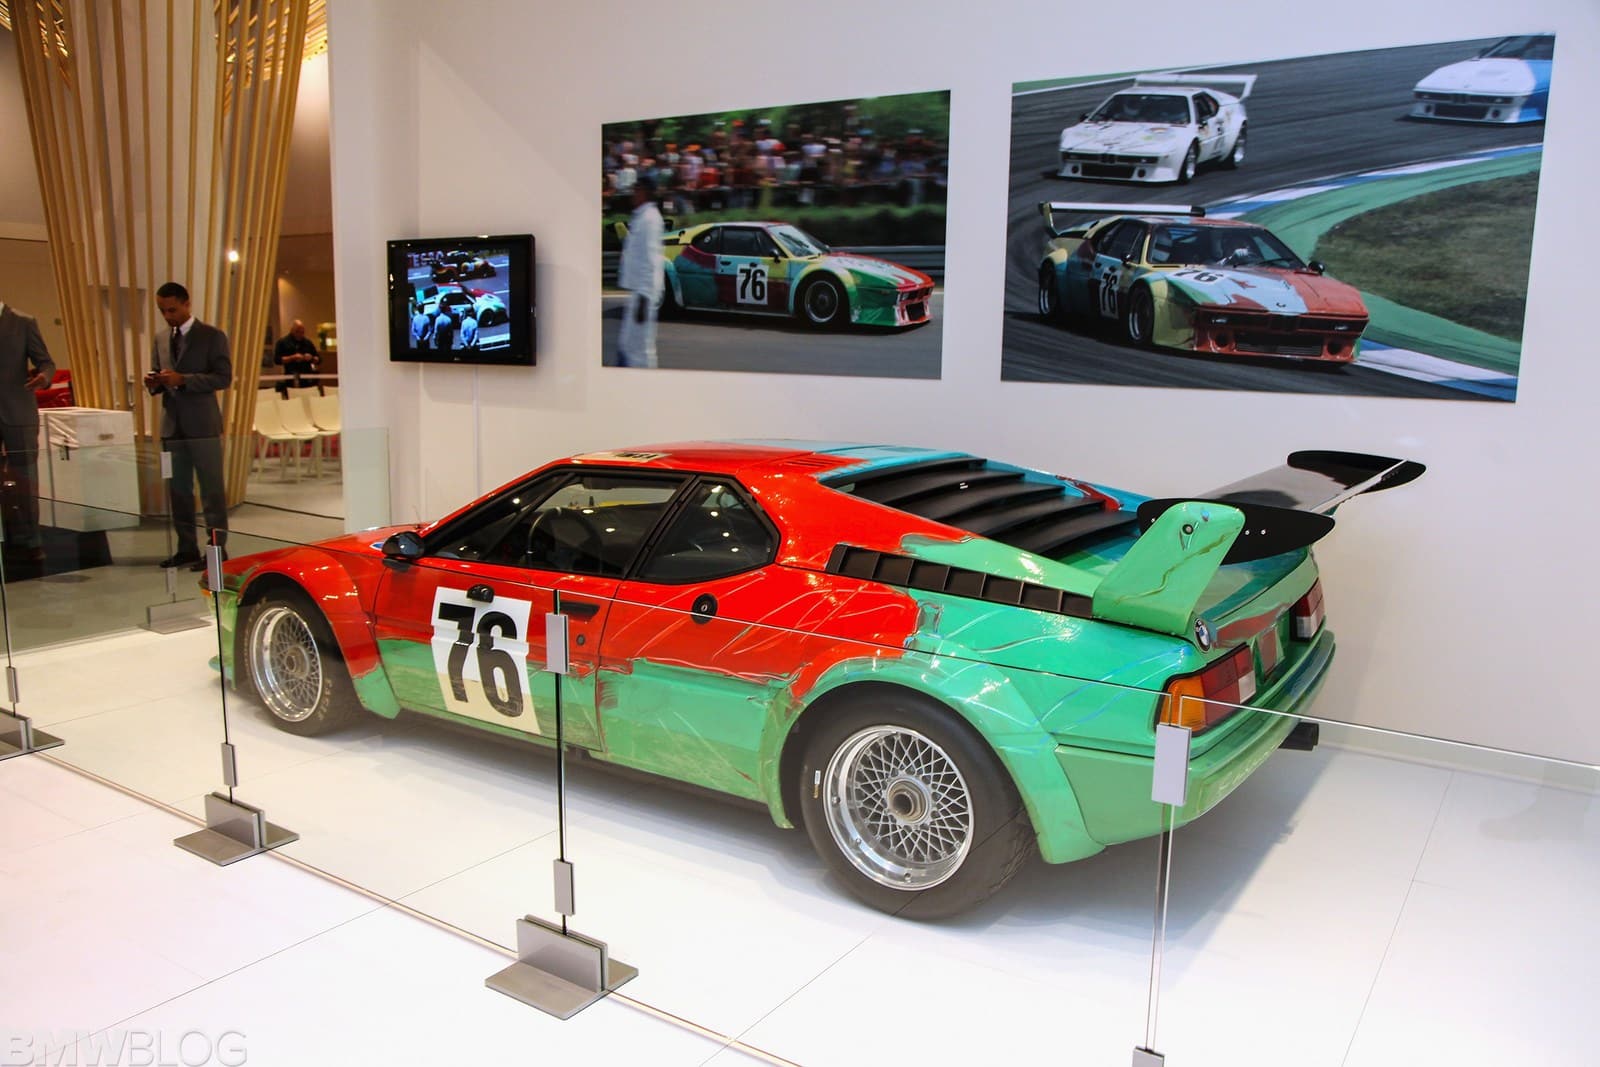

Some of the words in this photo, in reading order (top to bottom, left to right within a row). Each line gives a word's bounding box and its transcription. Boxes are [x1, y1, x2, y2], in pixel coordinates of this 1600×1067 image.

[740, 268, 765, 301] 76
[1102, 272, 1117, 313] 76
[1174, 270, 1218, 282] 76
[438, 602, 524, 718] 76
